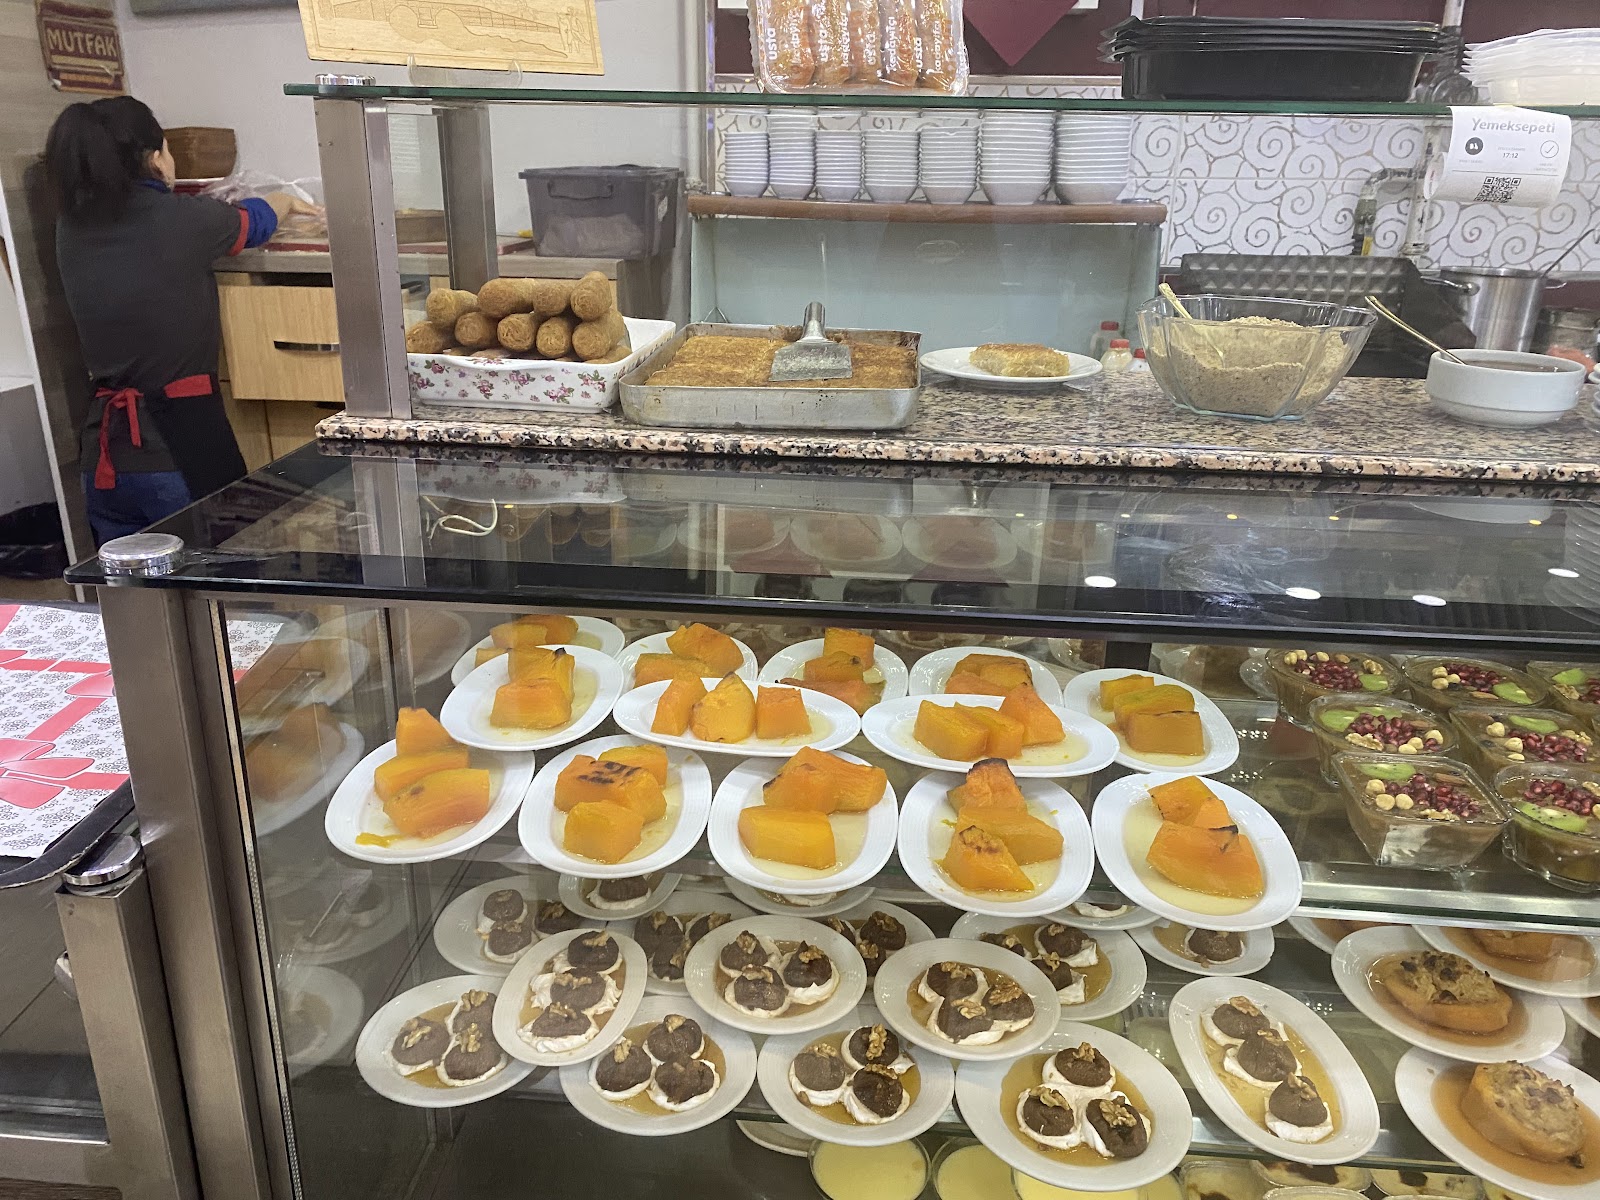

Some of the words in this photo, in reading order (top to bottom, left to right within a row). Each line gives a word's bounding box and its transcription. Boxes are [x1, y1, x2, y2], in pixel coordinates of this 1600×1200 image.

[46, 28, 118, 57] MUTFAK
[766, 28, 778, 60] usta
[914, 37, 923, 68] usta
[1472, 117, 1556, 134] Yemeksepeti
